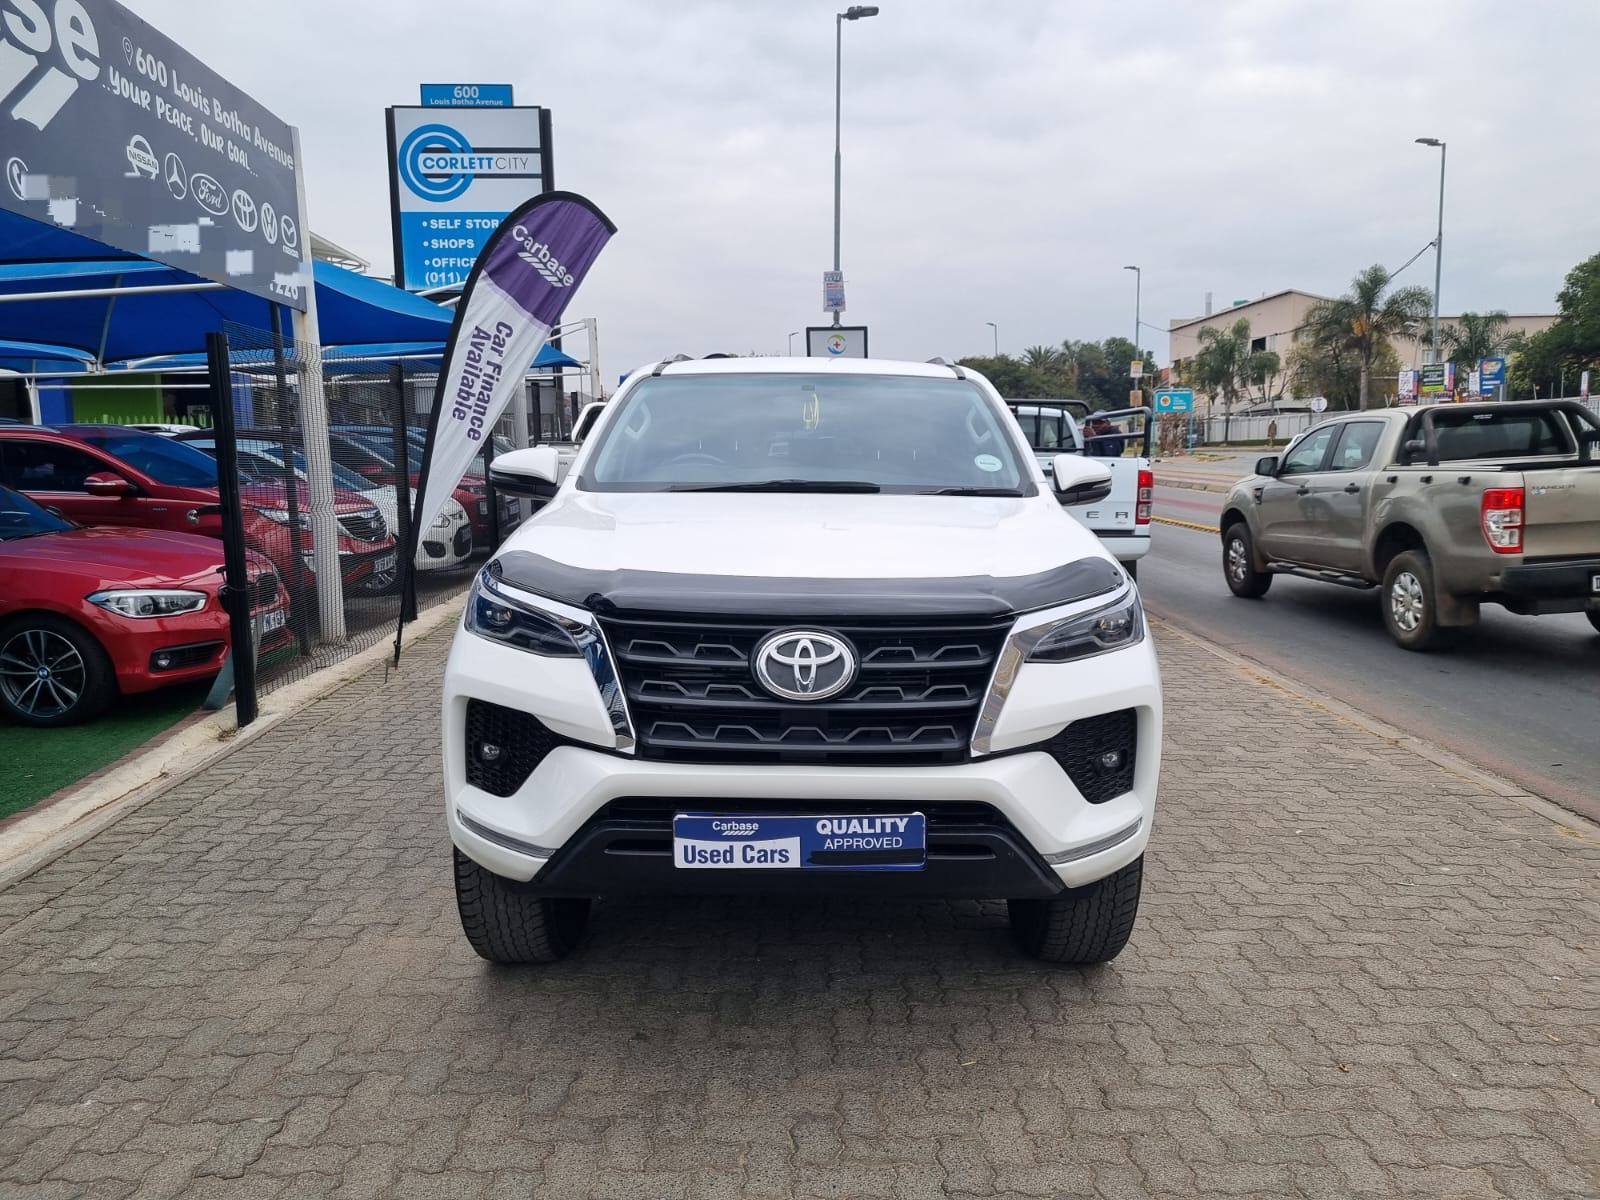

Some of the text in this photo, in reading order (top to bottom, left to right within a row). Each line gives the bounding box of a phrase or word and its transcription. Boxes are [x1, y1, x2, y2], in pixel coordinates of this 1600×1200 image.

[453, 85, 480, 99] 600
[430, 97, 504, 106] Louis Botha Avenue
[135, 47, 294, 171] 600 Louis Botha Avenue
[422, 156, 529, 170] CORLETT CITY
[429, 218, 503, 230] SELF STOR
[430, 238, 476, 249] SHOPS
[512, 224, 575, 287] Carbase
[425, 271, 461, 286] (011)
[452, 325, 492, 421] Available
[466, 320, 514, 442] Car Finance
[712, 820, 760, 832] Carbase
[815, 817, 909, 836] QUALITY
[823, 836, 903, 850] APPROVED
[683, 843, 790, 865] Used Cars
